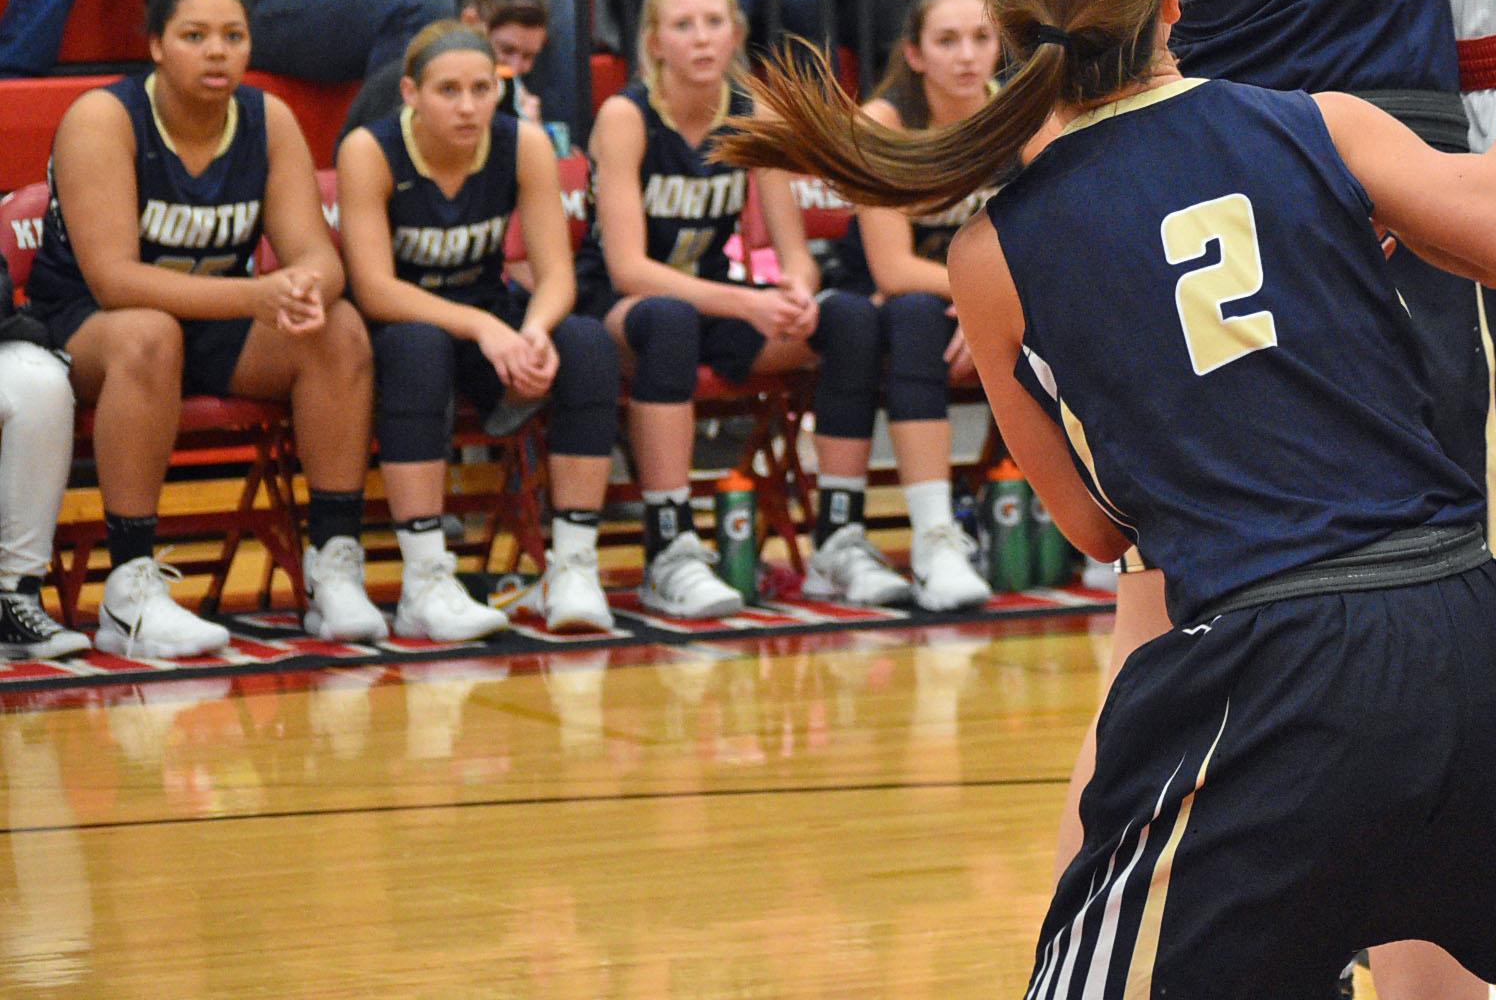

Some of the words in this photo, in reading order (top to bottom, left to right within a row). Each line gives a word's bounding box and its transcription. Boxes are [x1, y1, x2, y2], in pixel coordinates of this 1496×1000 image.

[140, 199, 260, 248] NORTH
[1160, 193, 1278, 376] 2
[723, 508, 751, 541] G
